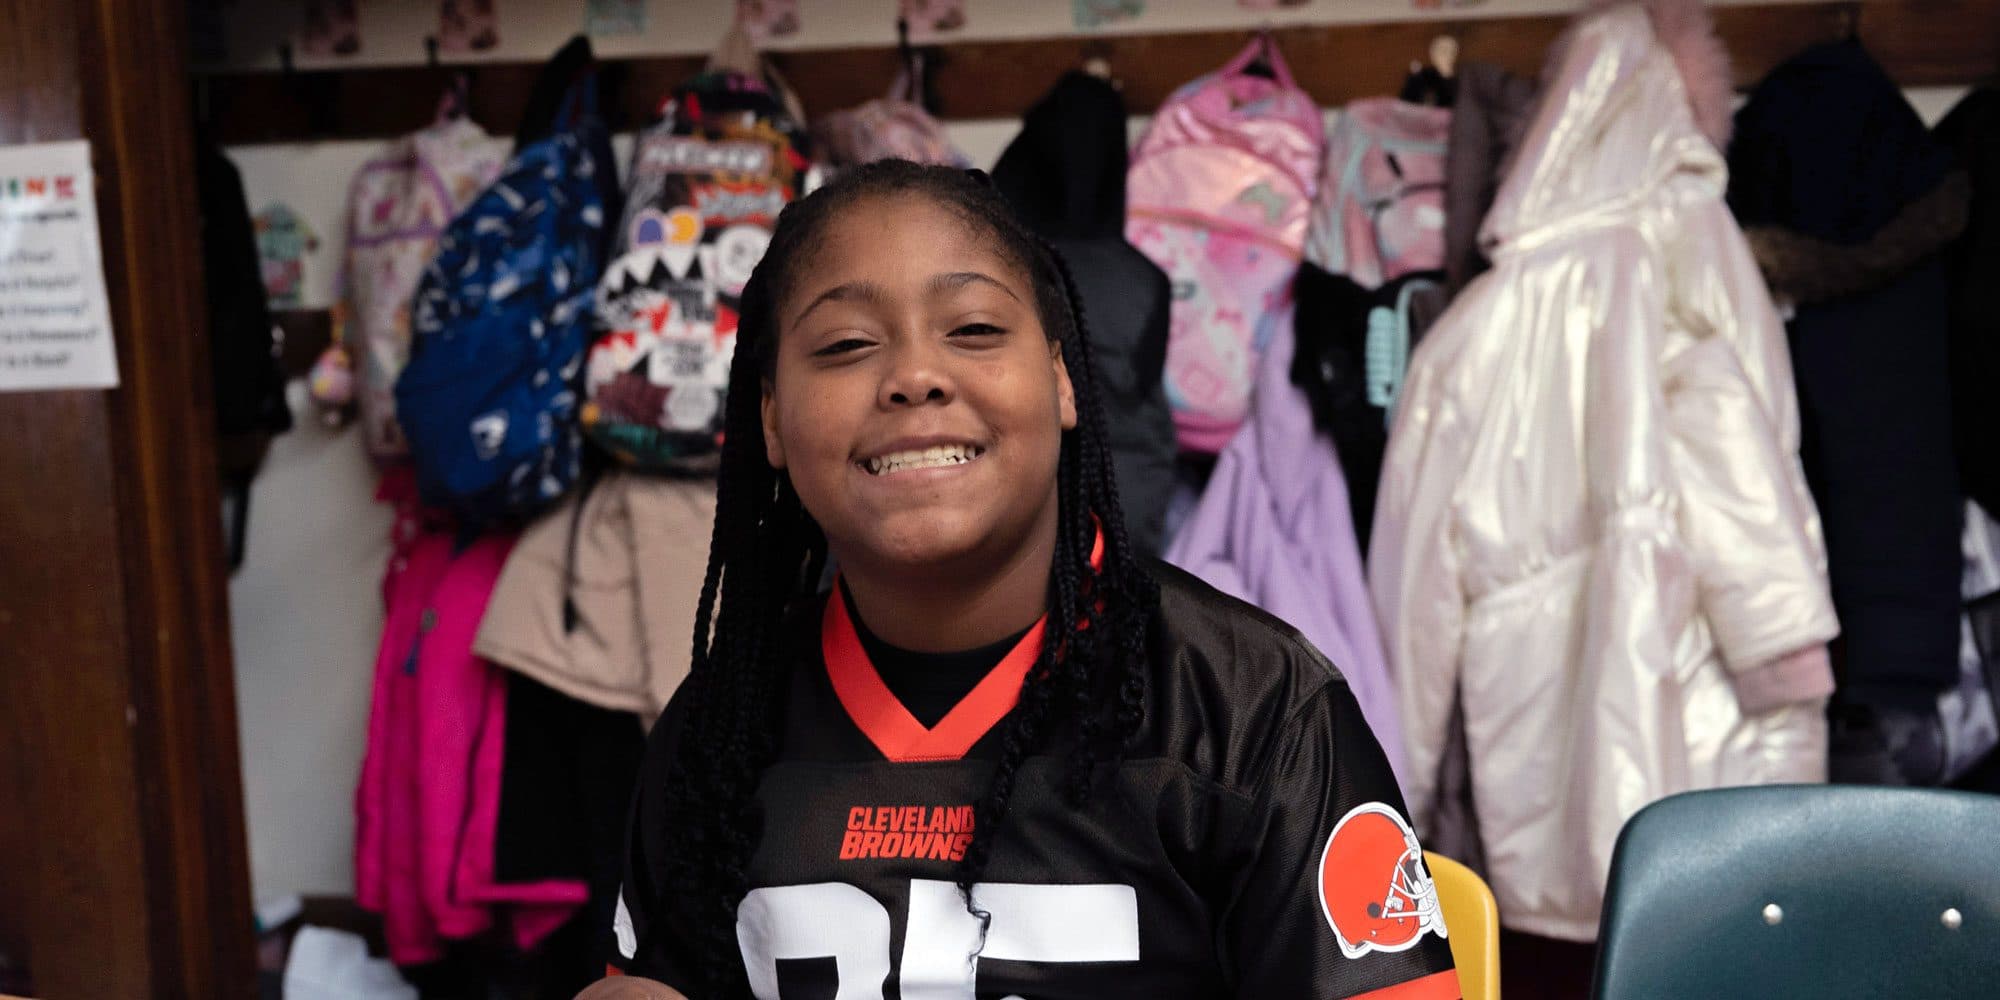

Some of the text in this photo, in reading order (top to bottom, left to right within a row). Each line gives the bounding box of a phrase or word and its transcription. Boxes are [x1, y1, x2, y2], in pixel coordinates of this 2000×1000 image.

[0, 175, 77, 200] INK
[847, 805, 976, 832] CLEVELAND
[839, 830, 974, 862] BROWNS
